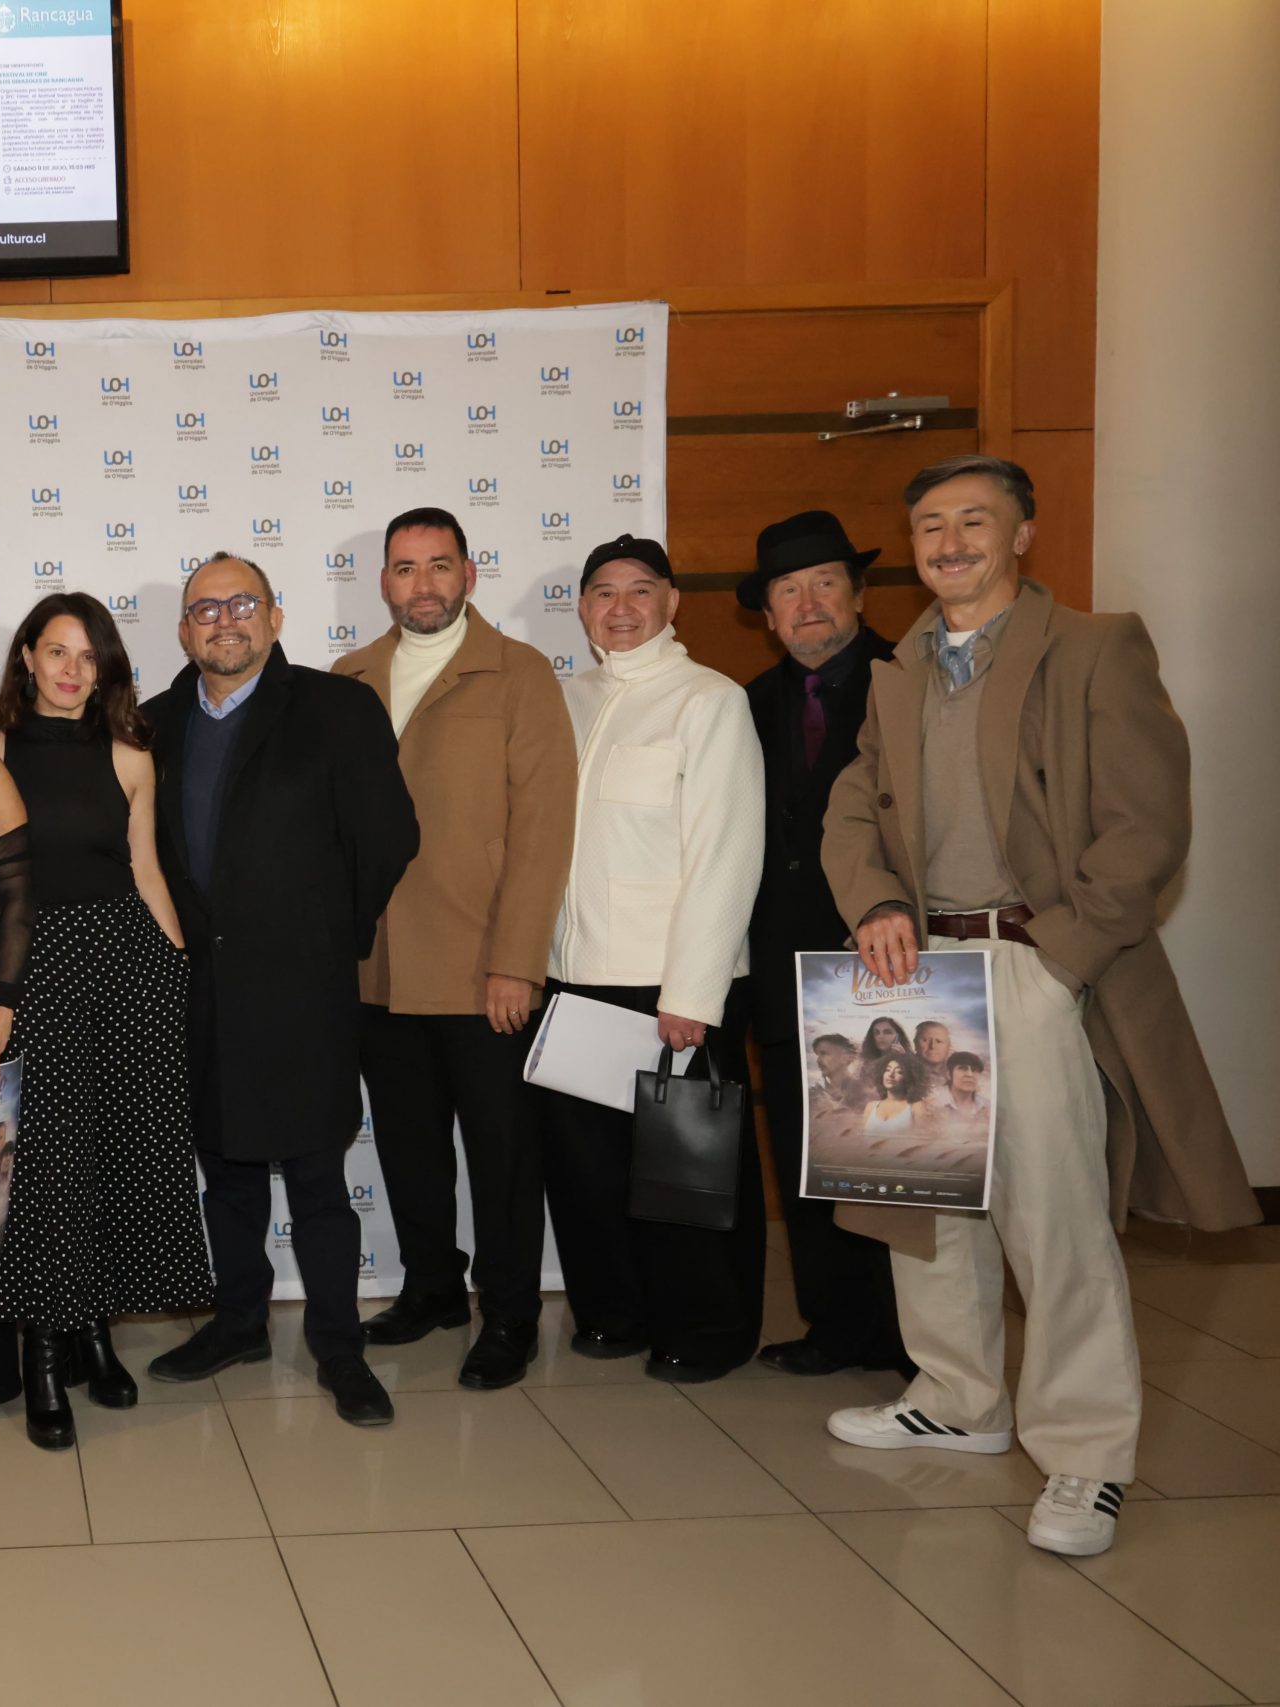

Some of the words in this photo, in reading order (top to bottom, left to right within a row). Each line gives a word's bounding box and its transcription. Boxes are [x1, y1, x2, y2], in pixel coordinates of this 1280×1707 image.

[20, 7, 93, 25] Rancagua
[320, 331, 347, 347] UOH
[468, 333, 495, 348] UOH
[616, 328, 644, 343] UOH
[26, 342, 54, 356] UOH
[250, 373, 277, 388] UOH
[541, 367, 568, 381] UOH
[177, 413, 204, 427] UOH
[104, 451, 132, 465] UOH
[325, 481, 351, 495] UOH
[613, 475, 640, 489] UOH
[253, 519, 280, 534] UOH
[542, 513, 569, 527] UOH
[854, 991, 874, 1001] QUE
[875, 988, 895, 998] NOS
[897, 987, 926, 996] LLEVA
